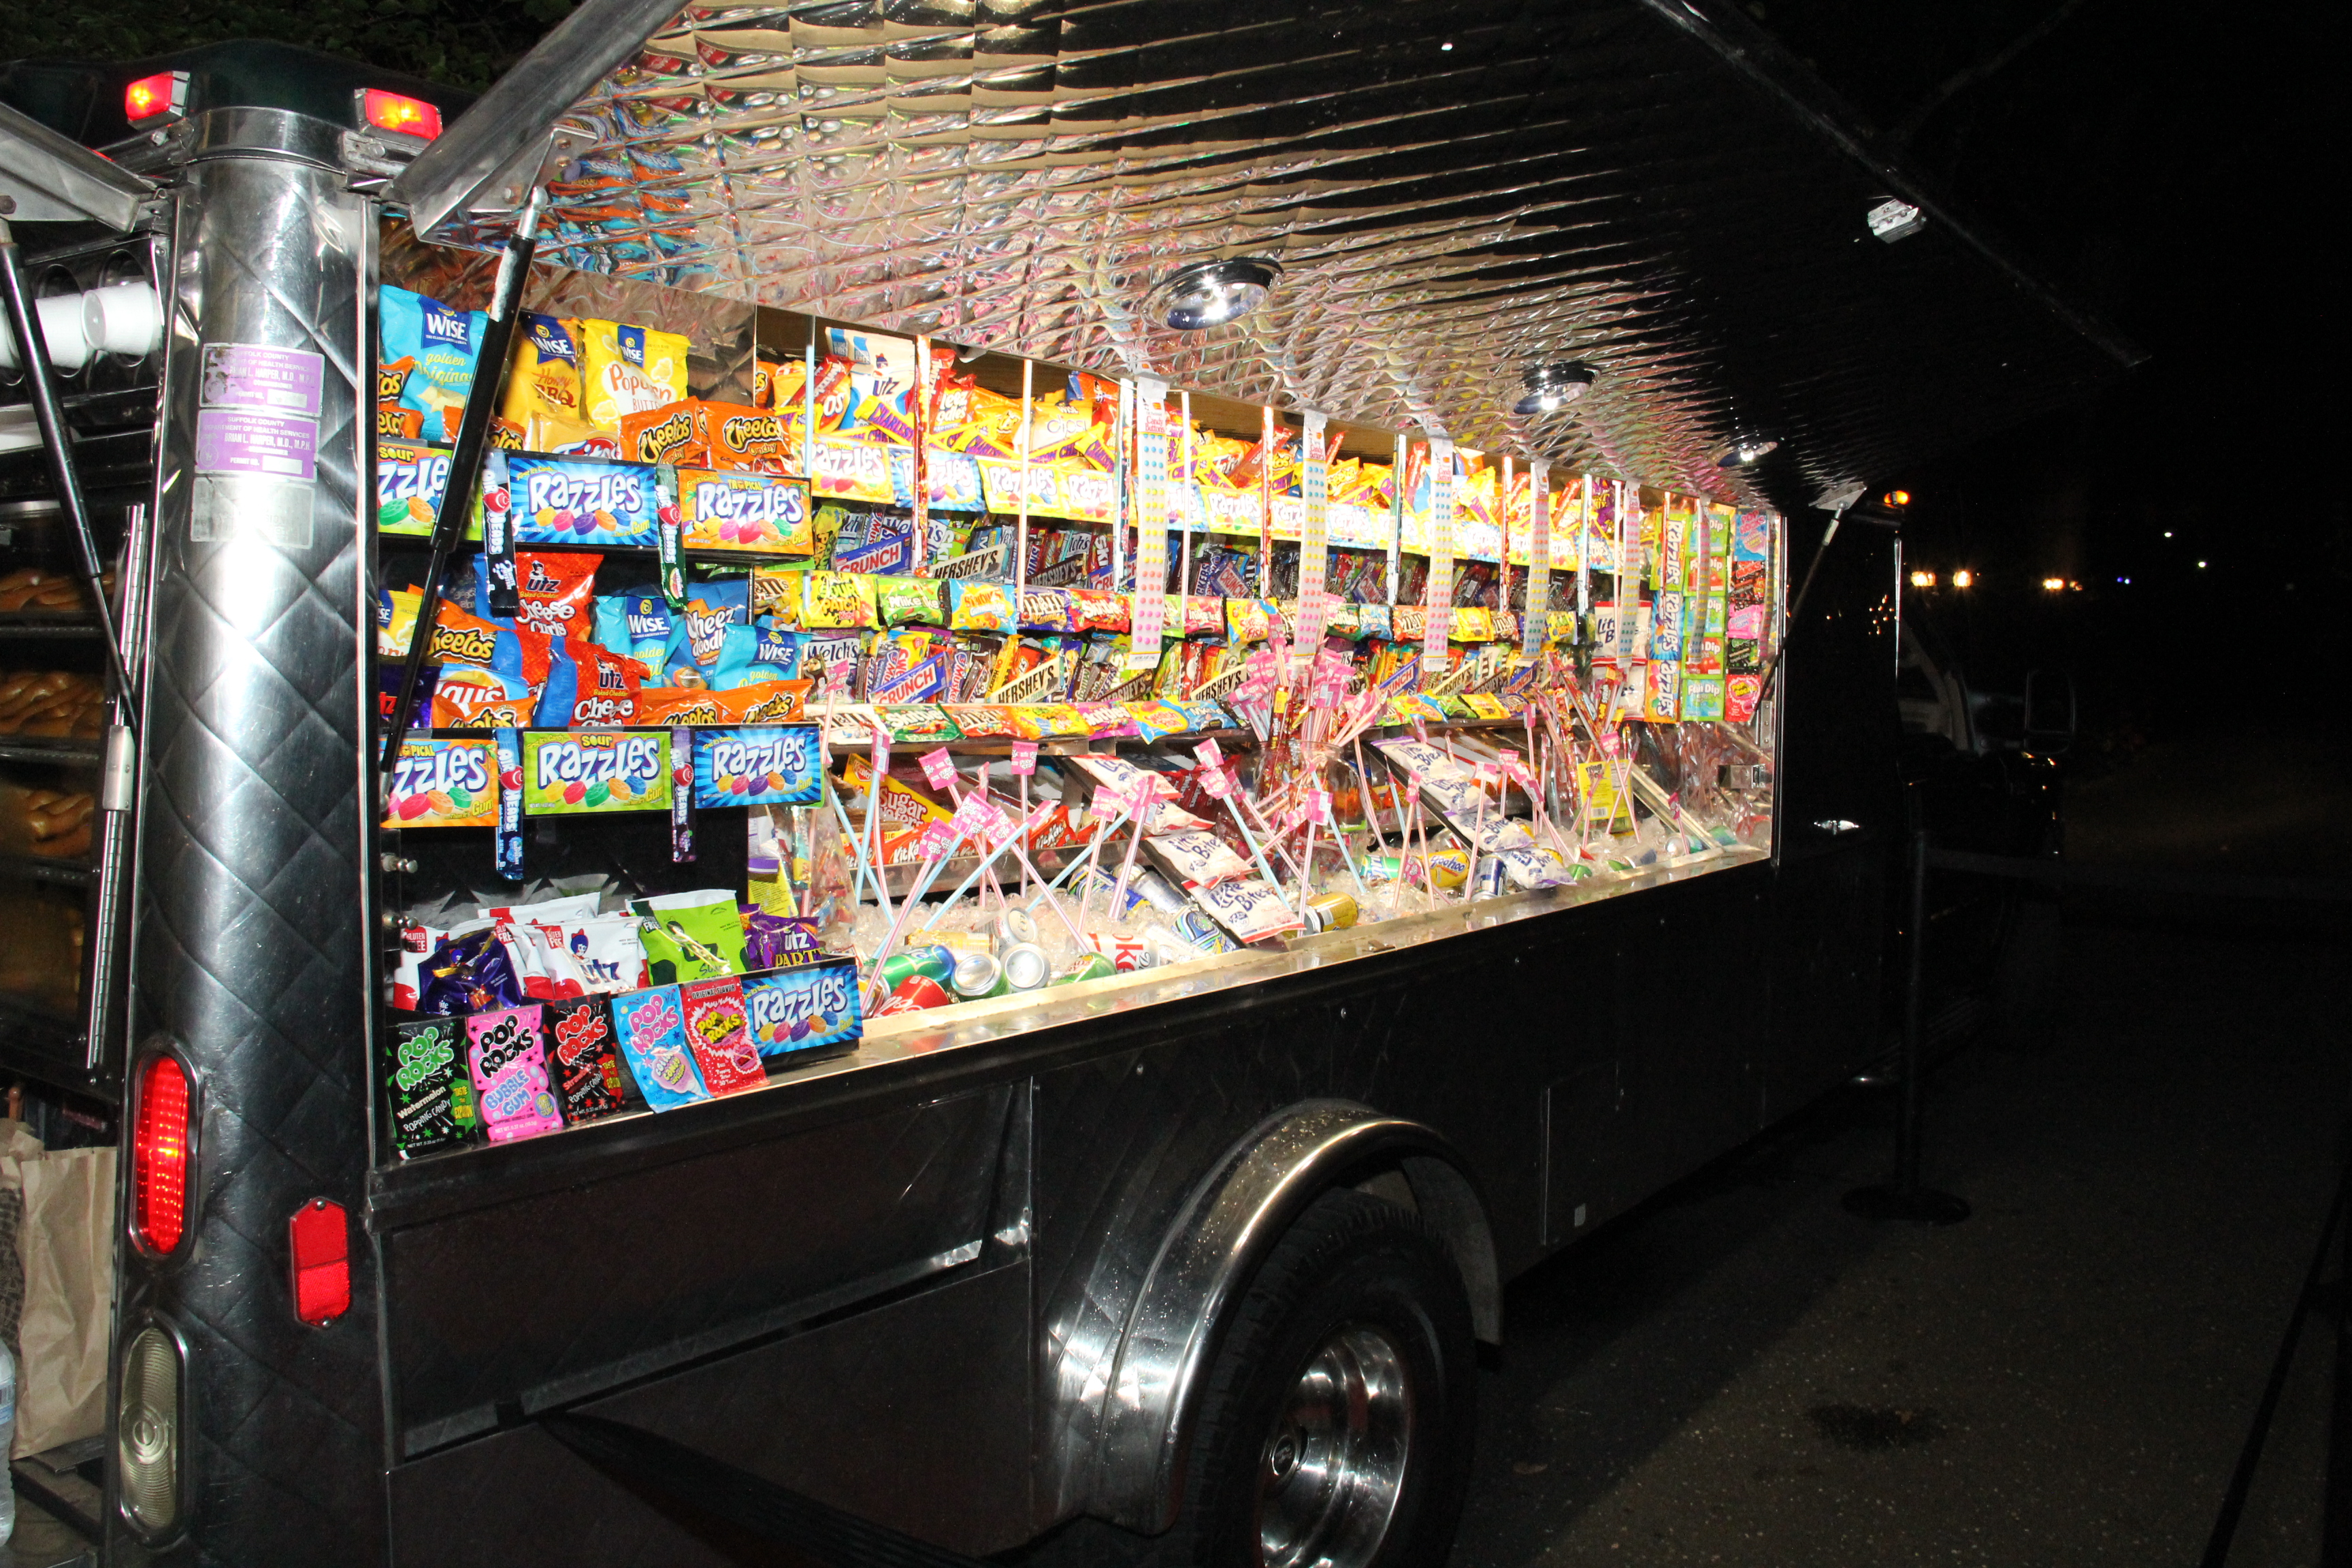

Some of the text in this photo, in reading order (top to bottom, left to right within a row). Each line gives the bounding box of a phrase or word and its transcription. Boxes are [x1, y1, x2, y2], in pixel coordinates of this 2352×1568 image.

[426, 313, 468, 340] WISE
[263, 350, 290, 361] COUNTY
[530, 336, 575, 355] WISE
[620, 344, 642, 361] WISE
[258, 360, 284, 368] HEALTH
[426, 353, 466, 368] golden
[414, 361, 475, 385] Origina
[532, 368, 573, 387] Honey
[536, 384, 577, 408] BBQ
[632, 398, 662, 412] BUTTE
[227, 416, 285, 427] SUFFOLK COUNTY
[868, 403, 914, 444] CHARLEST
[1145, 423, 1164, 433] Buttons
[1147, 417, 1163, 427] Candy
[225, 432, 243, 443] BRIAN
[250, 434, 276, 448] HARPER,
[252, 427, 279, 436] HEALTH
[280, 429, 310, 440] SERVICES
[637, 413, 693, 466] Cheetos
[380, 446, 414, 463] sour
[1309, 444, 1323, 453] Candy
[230, 457, 250, 466] PERMIT
[378, 455, 452, 508] zzle
[727, 478, 764, 491] TROPICAL
[928, 459, 972, 490] zzles
[527, 472, 643, 517] Razzles
[696, 480, 804, 525] Razzles
[631, 519, 651, 535] Gum
[791, 529, 809, 544] Gum
[1710, 520, 1724, 532] Dip
[840, 544, 900, 574] CRUNCH
[1667, 521, 1683, 585] Razzles
[934, 550, 998, 578] HERSHEY'S
[525, 576, 561, 592] utz
[818, 583, 859, 598] SOUR
[515, 598, 576, 625] Cheese
[820, 597, 861, 614] PATCH
[887, 596, 919, 608] Mike
[1708, 599, 1722, 612] Dip
[627, 615, 670, 634] WISE
[686, 607, 734, 638] Cheez
[1246, 627, 1264, 638] Fish
[1663, 593, 1680, 651] Razzles
[430, 630, 495, 659] heetos
[692, 629, 725, 657] doodl
[759, 644, 795, 663] WISE
[806, 642, 859, 664] Welch's
[1704, 642, 1721, 655] Dip
[598, 670, 626, 690] utz
[750, 670, 779, 681] golden
[879, 666, 934, 704] CRUNCH
[997, 664, 1054, 702] HERSHEY'S
[593, 689, 610, 697] Baked
[1657, 662, 1677, 718] azzles
[1688, 683, 1720, 696] Fun Dip
[1731, 682, 1746, 693] POP
[379, 691, 397, 715] tz
[1083, 705, 1131, 726] kittles
[581, 734, 613, 747] sour
[538, 736, 660, 790] Razzles
[711, 735, 806, 784] Razzles
[393, 745, 489, 802] zzles
[796, 777, 813, 791] Gum
[645, 786, 664, 802] Gum
[879, 787, 927, 819] Sugar
[471, 798, 494, 814] Gum
[908, 839, 920, 861] Ka
[1431, 855, 1465, 872] Yoohoo
[1235, 888, 1271, 912] Bites
[406, 932, 425, 941] GLUTEN
[642, 920, 662, 932] FREE
[497, 933, 513, 943] FRE
[784, 930, 811, 951] utz
[774, 947, 824, 968] PARTY
[691, 985, 736, 1000] ORIGINAL FLAVOR
[628, 994, 664, 1034] POP
[753, 975, 849, 1032] Razzles
[479, 1013, 519, 1054] POP
[555, 1004, 591, 1044] POP
[630, 1005, 680, 1055] ROCKS
[696, 1011, 719, 1035] POP
[706, 1013, 744, 1043] ROCKS
[838, 1015, 855, 1032] Gum
[398, 1027, 439, 1066] POP
[557, 1015, 608, 1066] ROCKS
[478, 1026, 536, 1079] ROCKS
[396, 1039, 455, 1091] ROCKS
[483, 1068, 531, 1110] BUBBLE
[568, 1082, 591, 1103] POPPING
[589, 1071, 604, 1088] CANDY
[396, 1085, 446, 1119] Watermelon
[502, 1088, 532, 1116] GUM
[403, 1098, 452, 1132] POPPING CANDY
